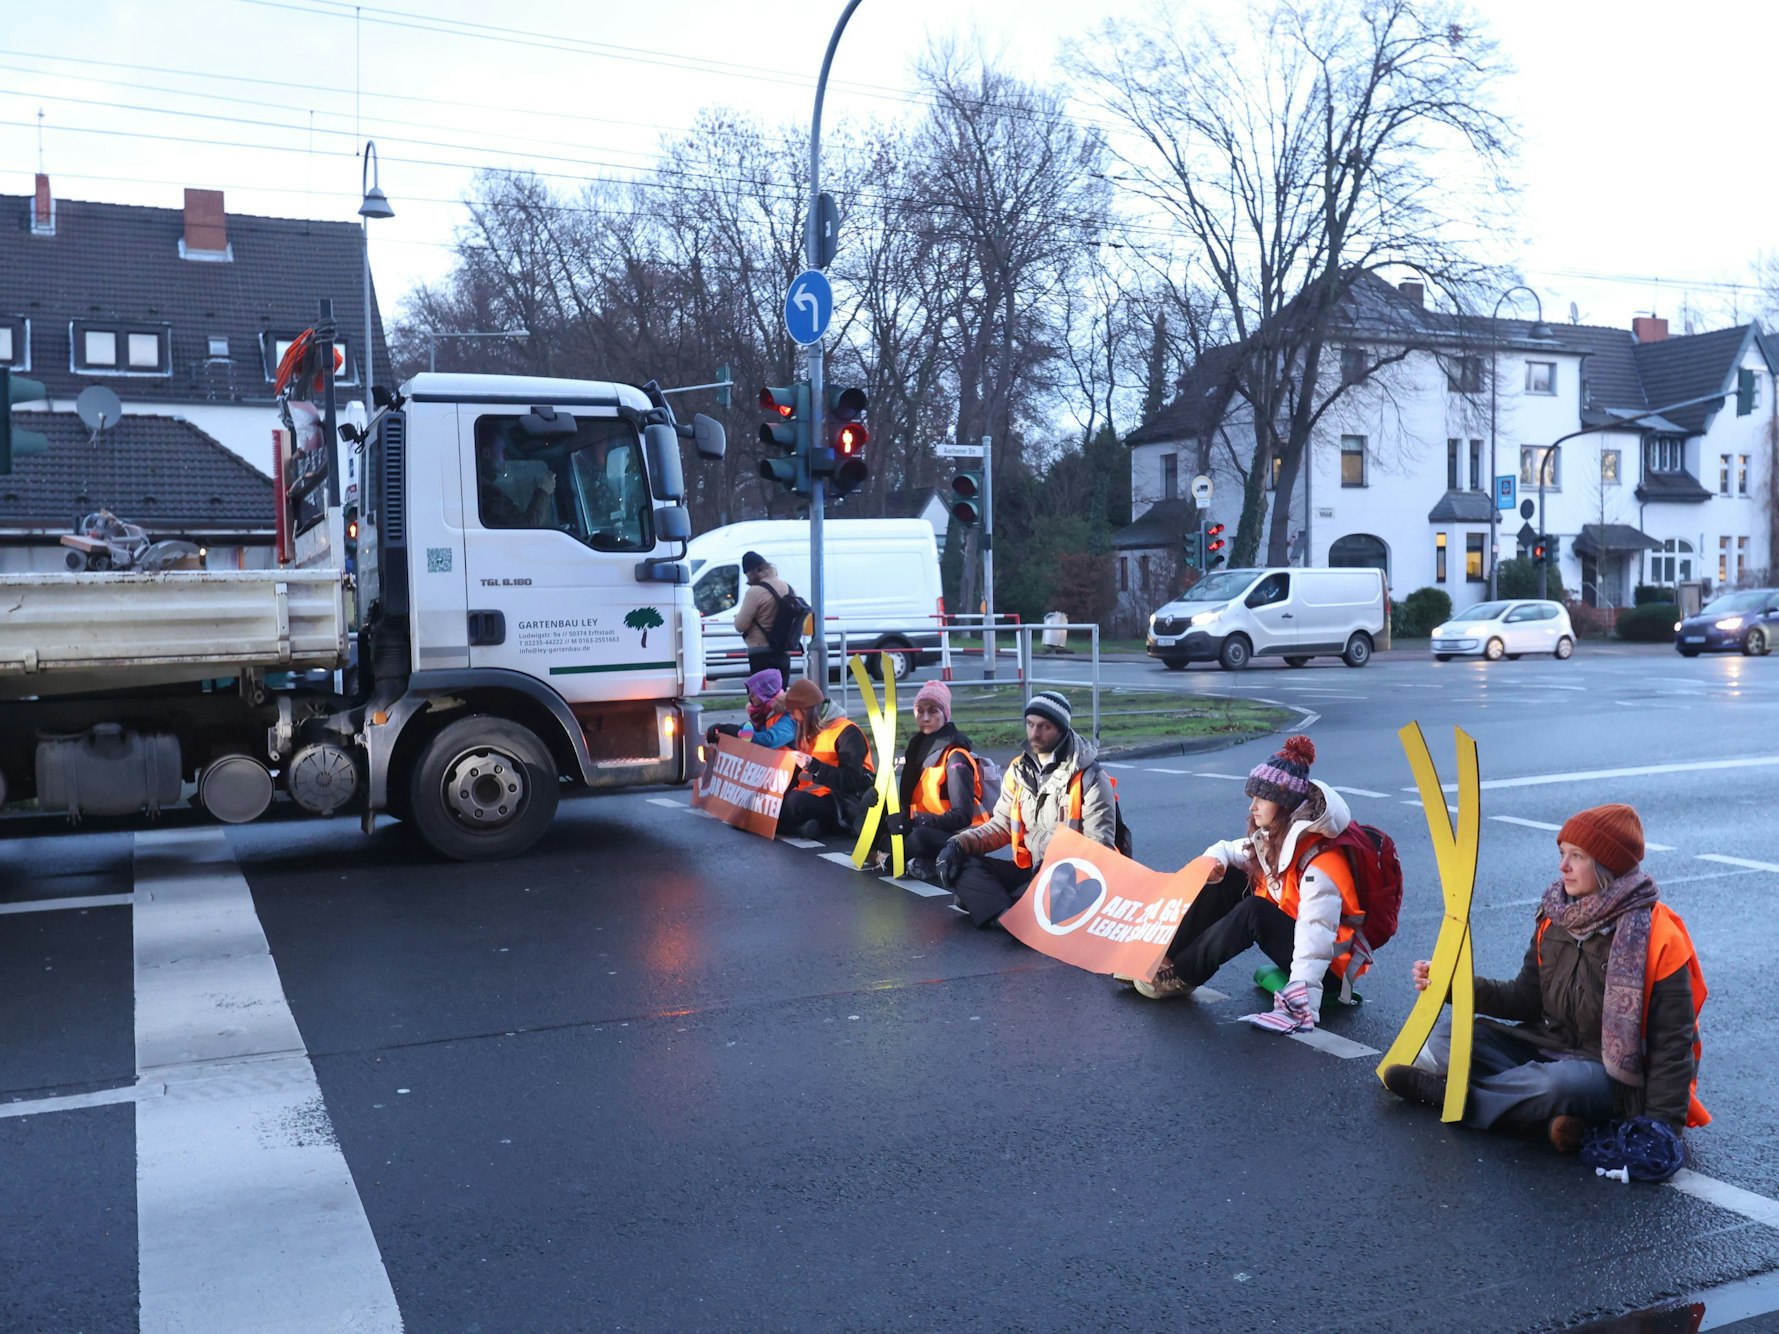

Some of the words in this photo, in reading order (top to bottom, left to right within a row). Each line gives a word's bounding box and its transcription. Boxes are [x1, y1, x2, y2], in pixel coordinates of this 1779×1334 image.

[480, 579, 501, 587] TGL
[518, 619, 579, 630] GARTENBAU
[581, 618, 598, 627] LEY
[1100, 895, 1145, 922] ART.
